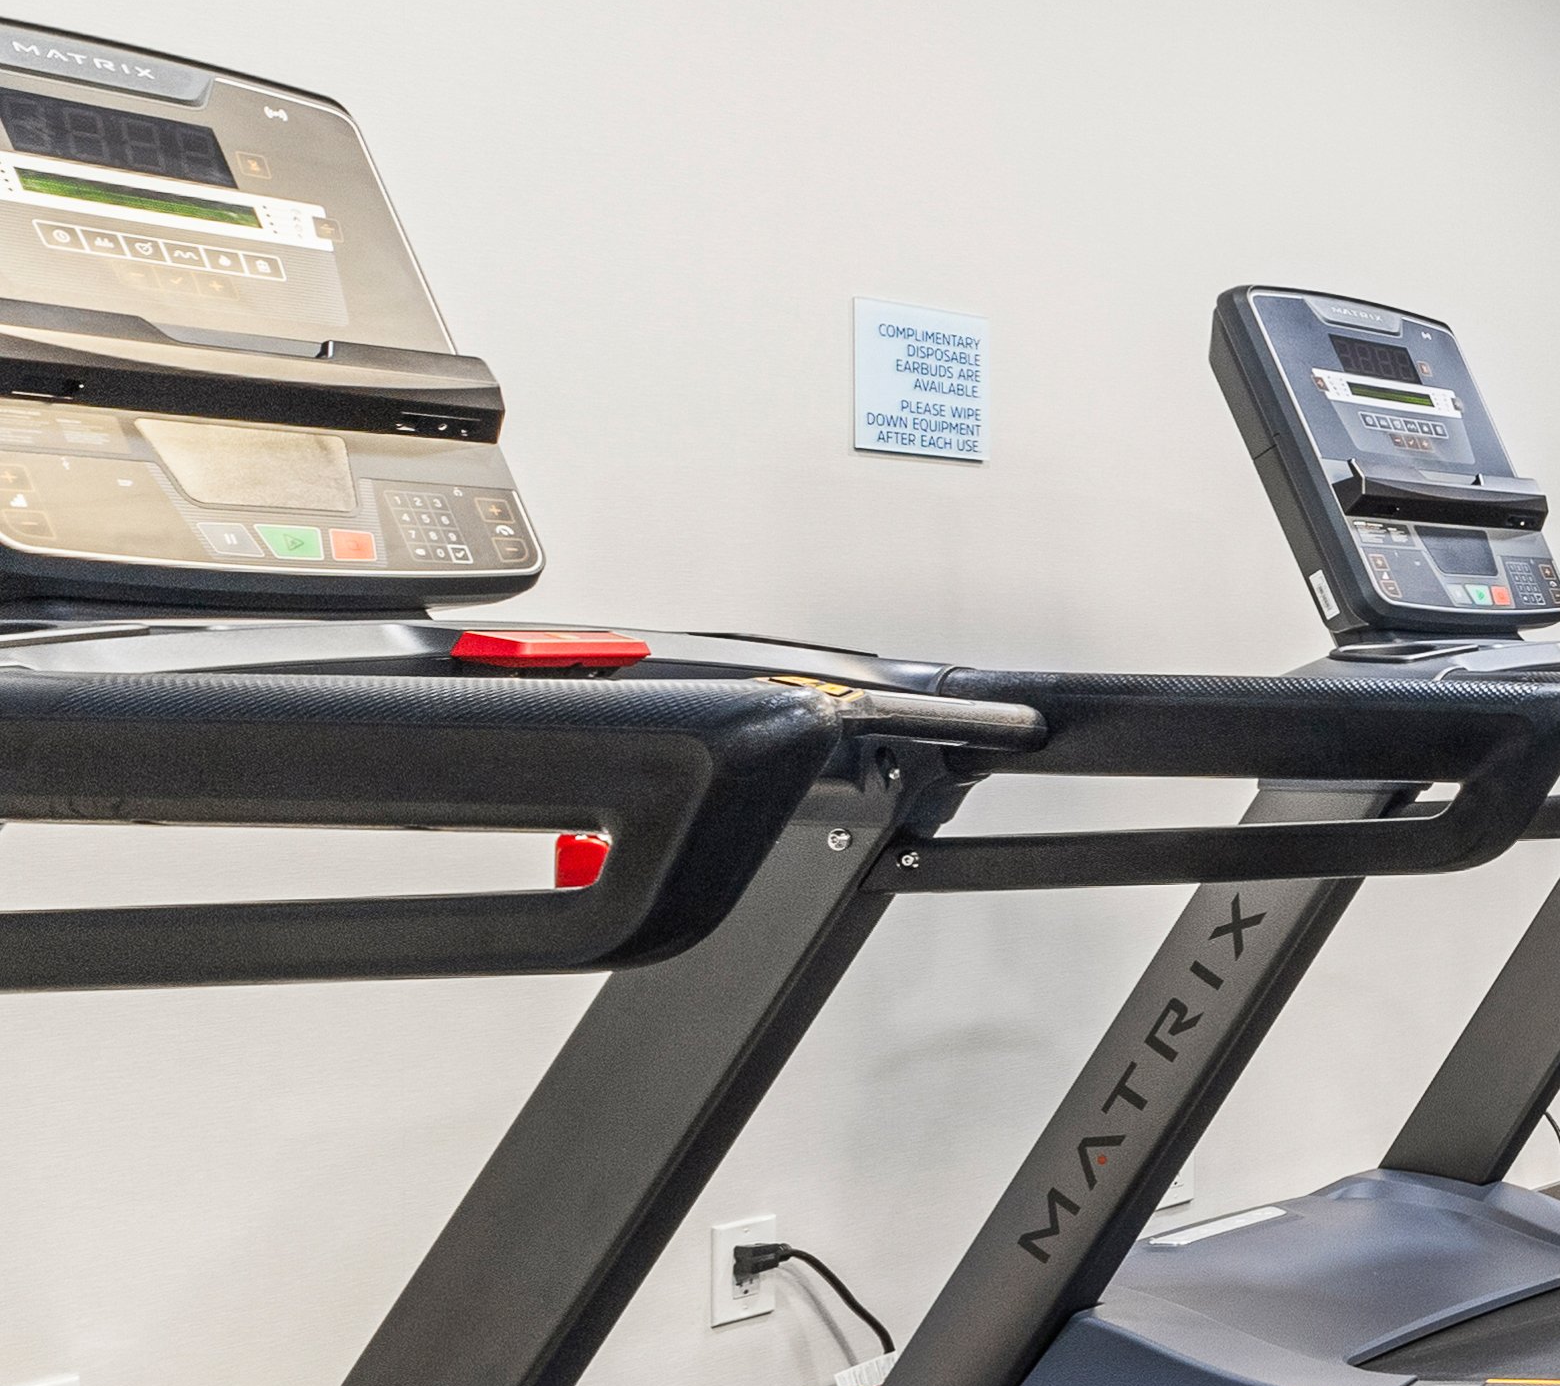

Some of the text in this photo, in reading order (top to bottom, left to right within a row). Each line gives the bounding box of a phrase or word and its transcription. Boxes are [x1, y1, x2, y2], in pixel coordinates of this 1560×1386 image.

[11, 40, 156, 81] MATRIX
[1331, 306, 1383, 322] MATRIX
[878, 323, 980, 350] COMPLIMENTARY
[907, 344, 981, 367] DISPOSABLE
[896, 359, 981, 383] EARBUDS ARE
[900, 399, 981, 422] PLEASE WIPE
[867, 412, 982, 437] DOWN EQUIPMENT
[877, 430, 916, 446] AFTER
[920, 434, 952, 450] EACH
[1017, 892, 1267, 1264] MATRIX
